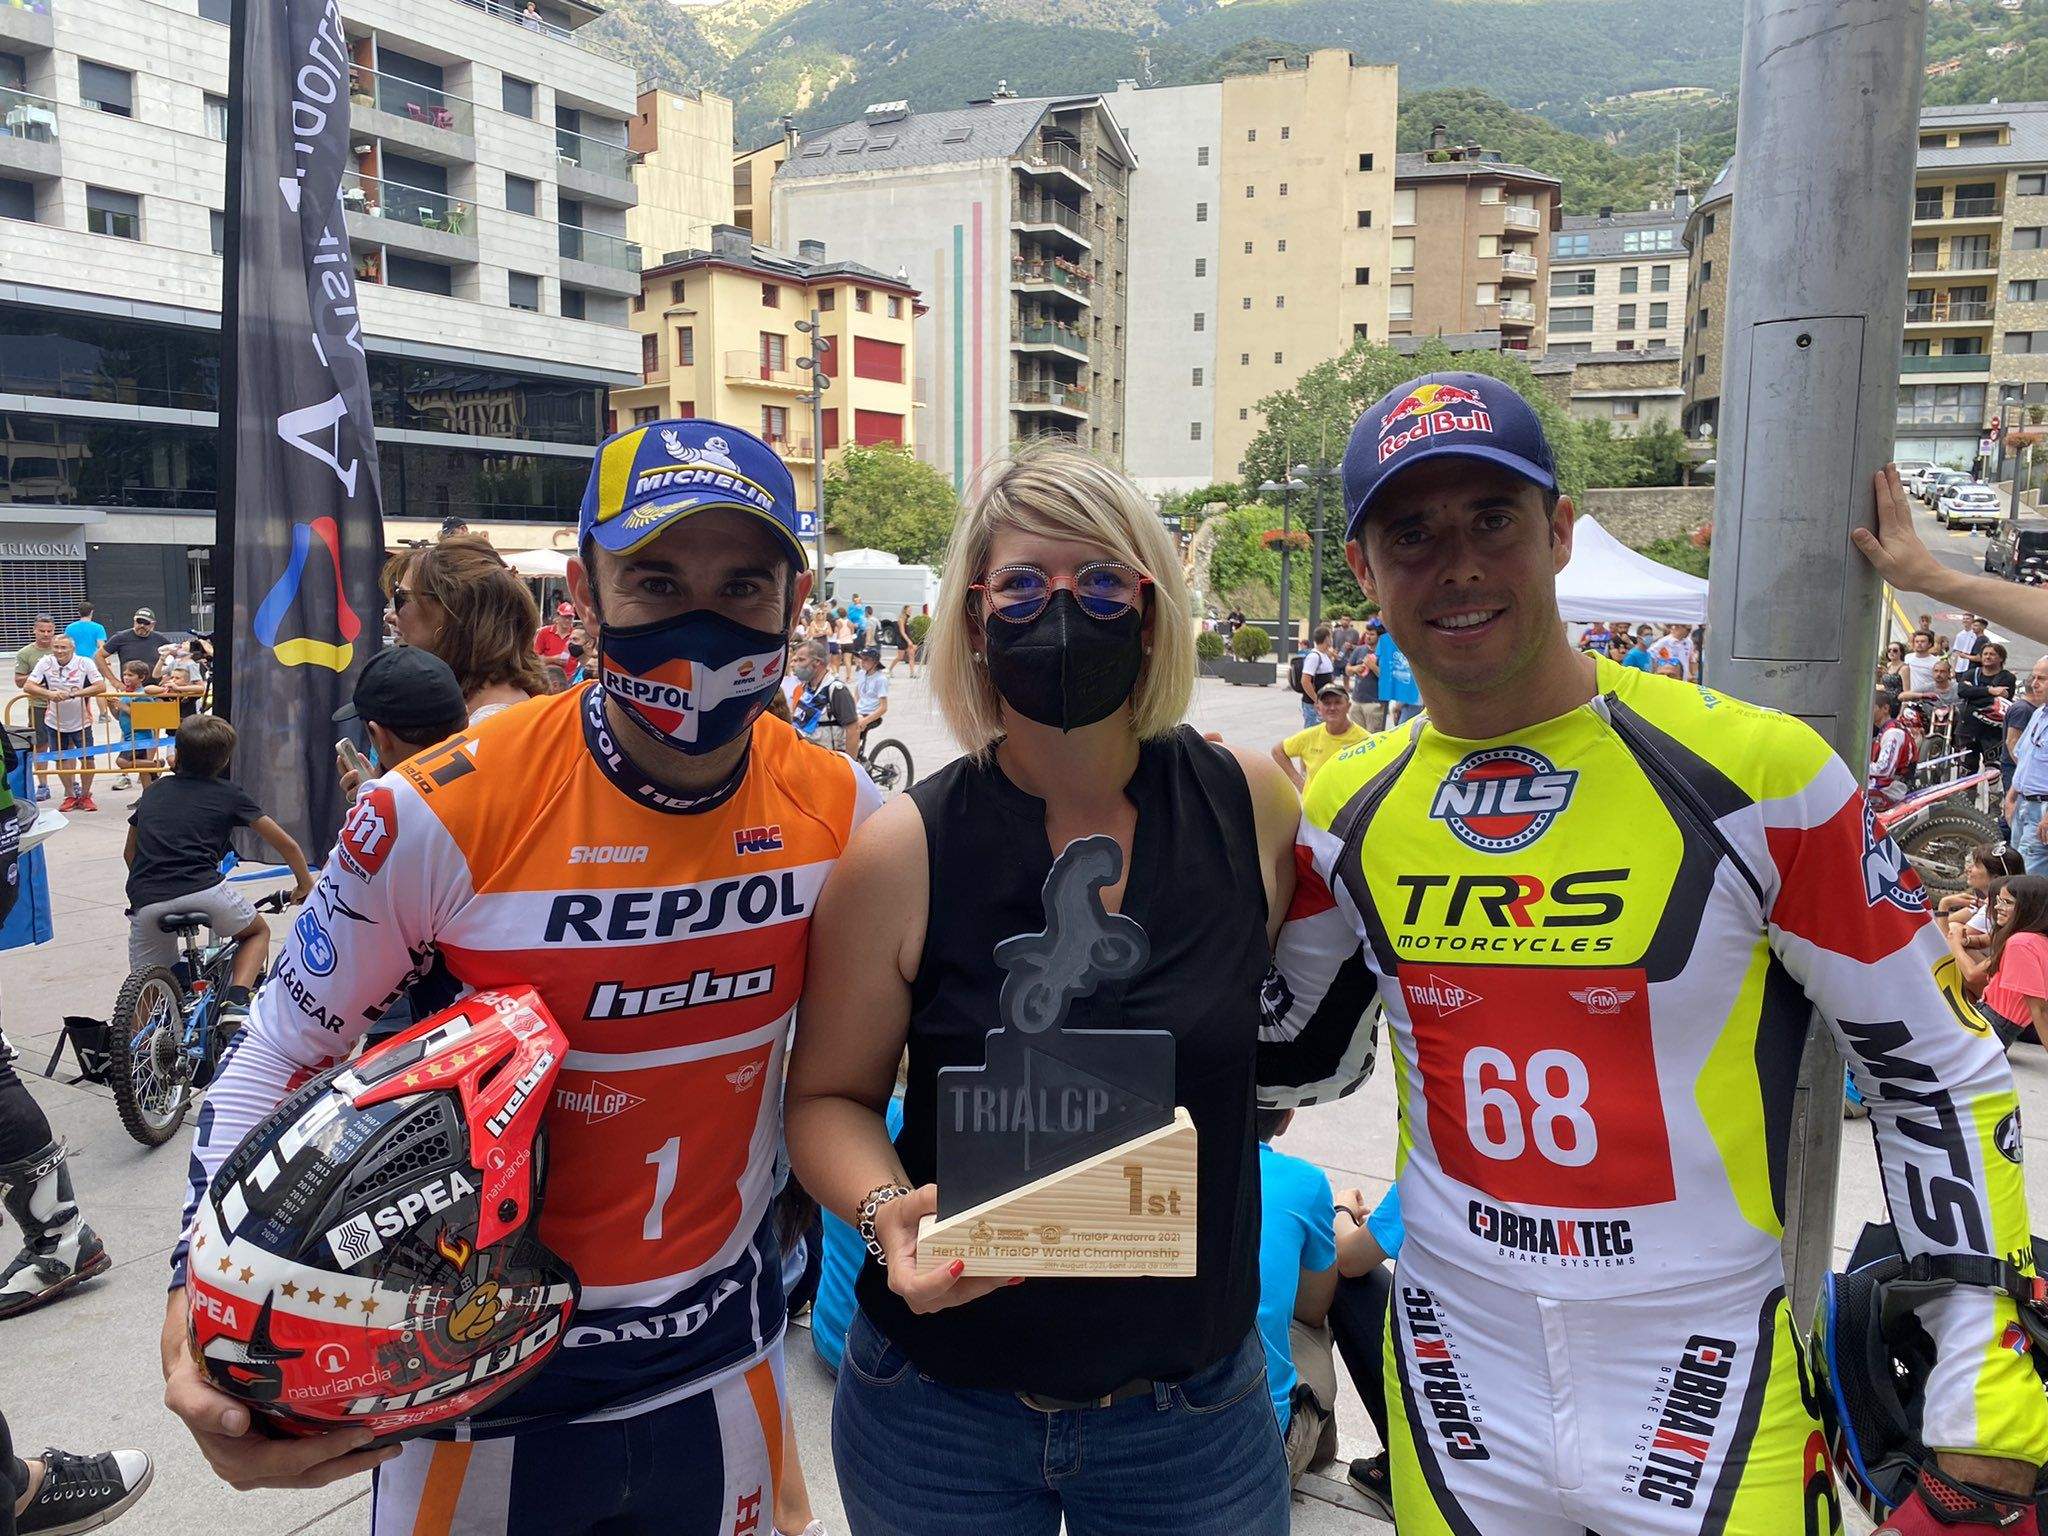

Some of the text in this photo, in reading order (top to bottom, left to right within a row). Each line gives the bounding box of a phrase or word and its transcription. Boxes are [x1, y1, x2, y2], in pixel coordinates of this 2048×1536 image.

[1378, 410, 1493, 465] Red Bull
[635, 470, 774, 512] MICHELIN
[605, 670, 694, 711] REPSOL
[1433, 774, 1573, 816] NILS
[734, 825, 784, 857] HRC
[567, 844, 649, 865] SHOWA
[544, 871, 806, 943] REPSOL
[1396, 867, 1632, 928] TRRS
[1397, 934, 1614, 952] MOTORCYCLES
[584, 966, 775, 1020] hebo
[1406, 985, 1465, 1008] TRIALGP
[1591, 995, 1615, 1007] FIM
[484, 1050, 556, 1138] hebo
[556, 1089, 628, 1114] TRIALGP
[948, 1087, 1110, 1133] TRIALGP
[1462, 1045, 1599, 1168] 68
[353, 1120, 372, 1135] 2008
[361, 1113, 381, 1127] 2007
[345, 1128, 363, 1142] 2009
[312, 1161, 331, 1177] 2013
[320, 1154, 339, 1169] 2012
[304, 1170, 323, 1186] 2014
[485, 1147, 531, 1202] naturlandia
[289, 1189, 307, 1206] 2016
[297, 1180, 315, 1196] 2015
[642, 1136, 681, 1240] 1
[1122, 1166, 1181, 1216] 1st
[275, 1208, 293, 1224] 2018
[282, 1198, 301, 1214] 2017
[374, 1170, 476, 1238] SPEA
[261, 1227, 279, 1244] 2020
[268, 1218, 286, 1234] 2019
[1071, 1232, 1181, 1243] TrialGP Andorra 2021
[932, 1246, 1181, 1261] Hertz FIM TrialGP World Championship
[1498, 1247, 1636, 1268] BRAKE SYSTEMS
[1429, 1290, 1483, 1423] BRAKE SYSTEMS
[287, 1366, 391, 1400] naturlandia
[1621, 1366, 1672, 1493] BRAKE SYSTEMS
